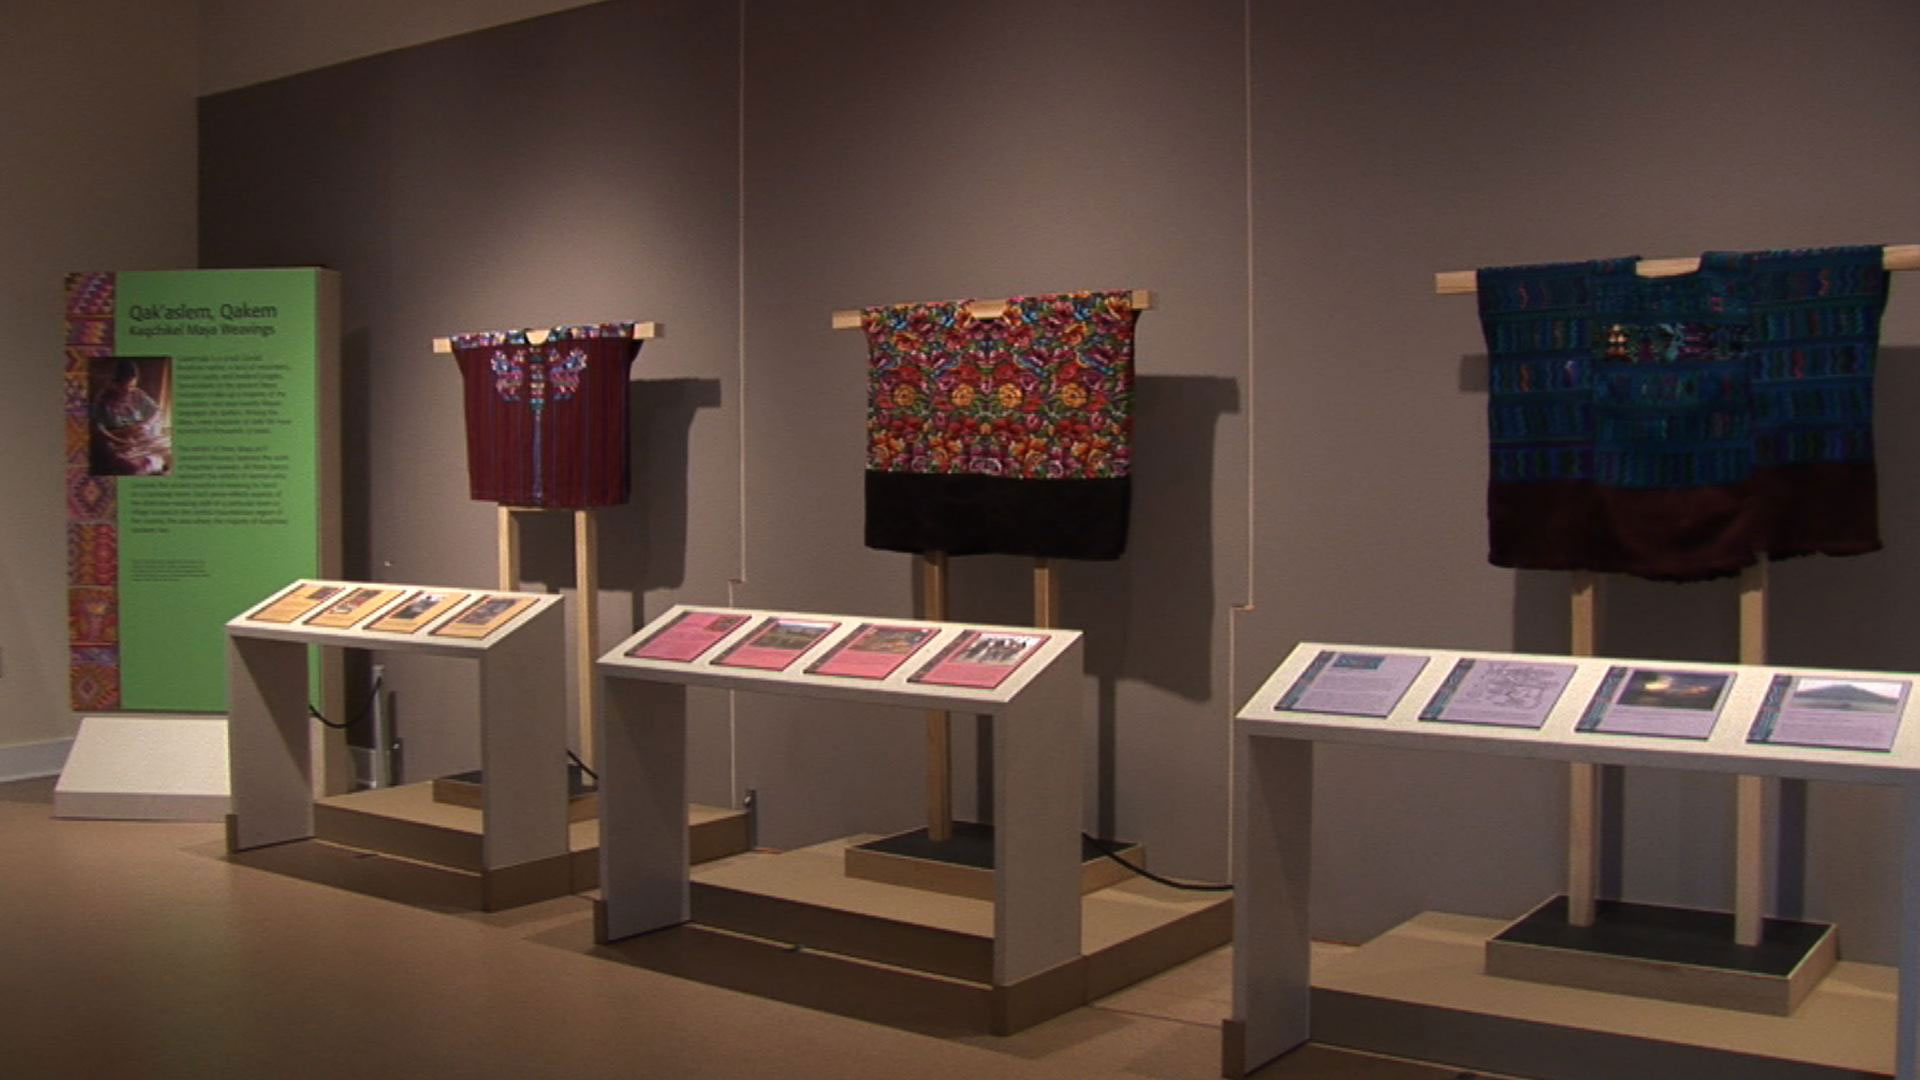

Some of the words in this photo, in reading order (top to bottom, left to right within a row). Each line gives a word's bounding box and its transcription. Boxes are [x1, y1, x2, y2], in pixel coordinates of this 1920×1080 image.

[220, 302, 278, 321] Qakem
[187, 324, 218, 338] Maya
[221, 324, 276, 338] Weavings
